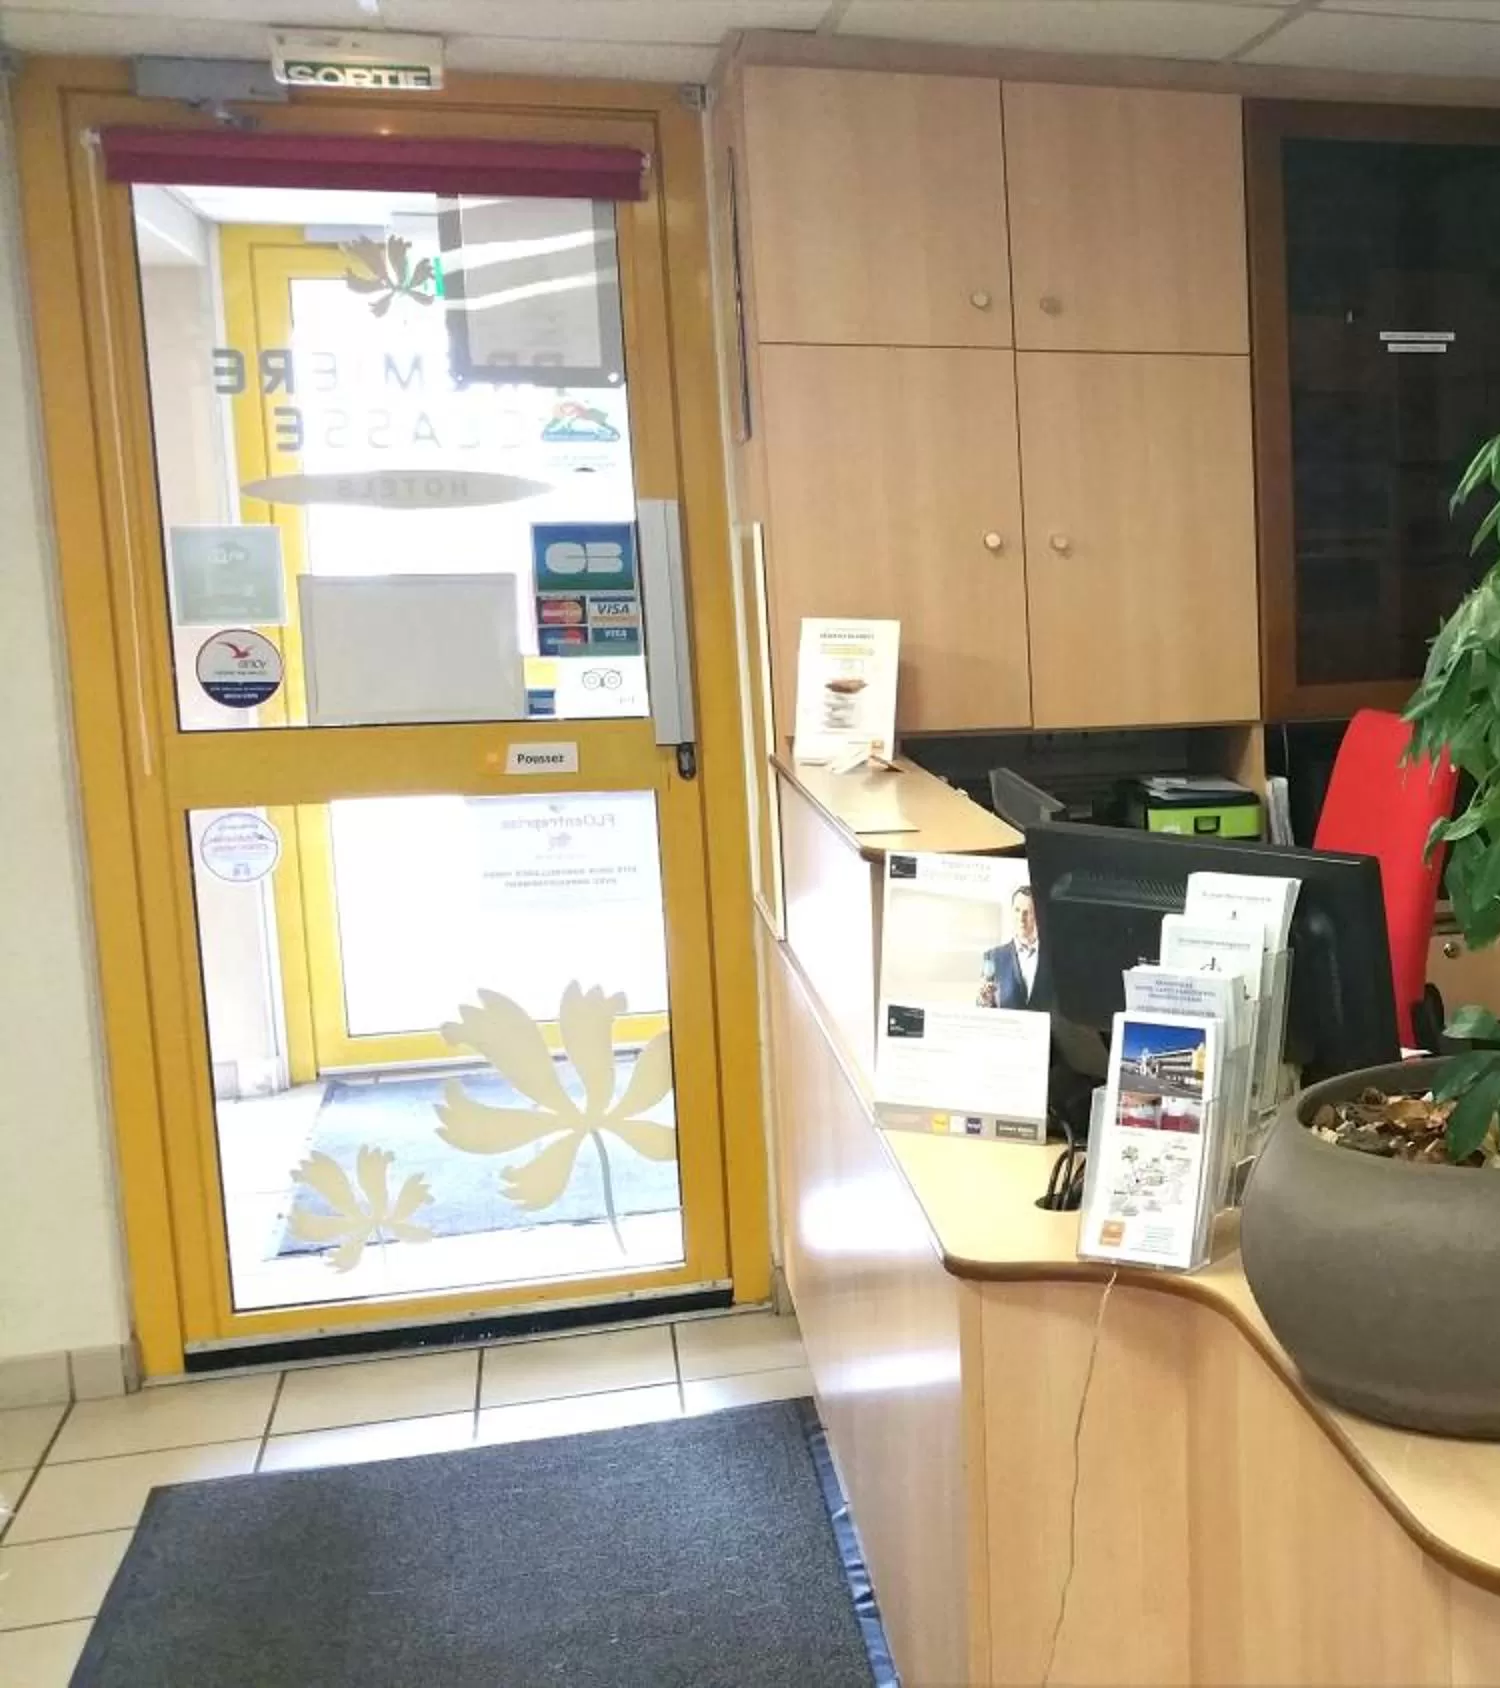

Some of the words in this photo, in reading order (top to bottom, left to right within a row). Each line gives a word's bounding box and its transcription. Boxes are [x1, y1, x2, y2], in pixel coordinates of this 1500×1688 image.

[287, 64, 431, 88] SORTIE
[545, 541, 624, 574] CB
[597, 603, 629, 615] VISA
[604, 629, 627, 638] VISA
